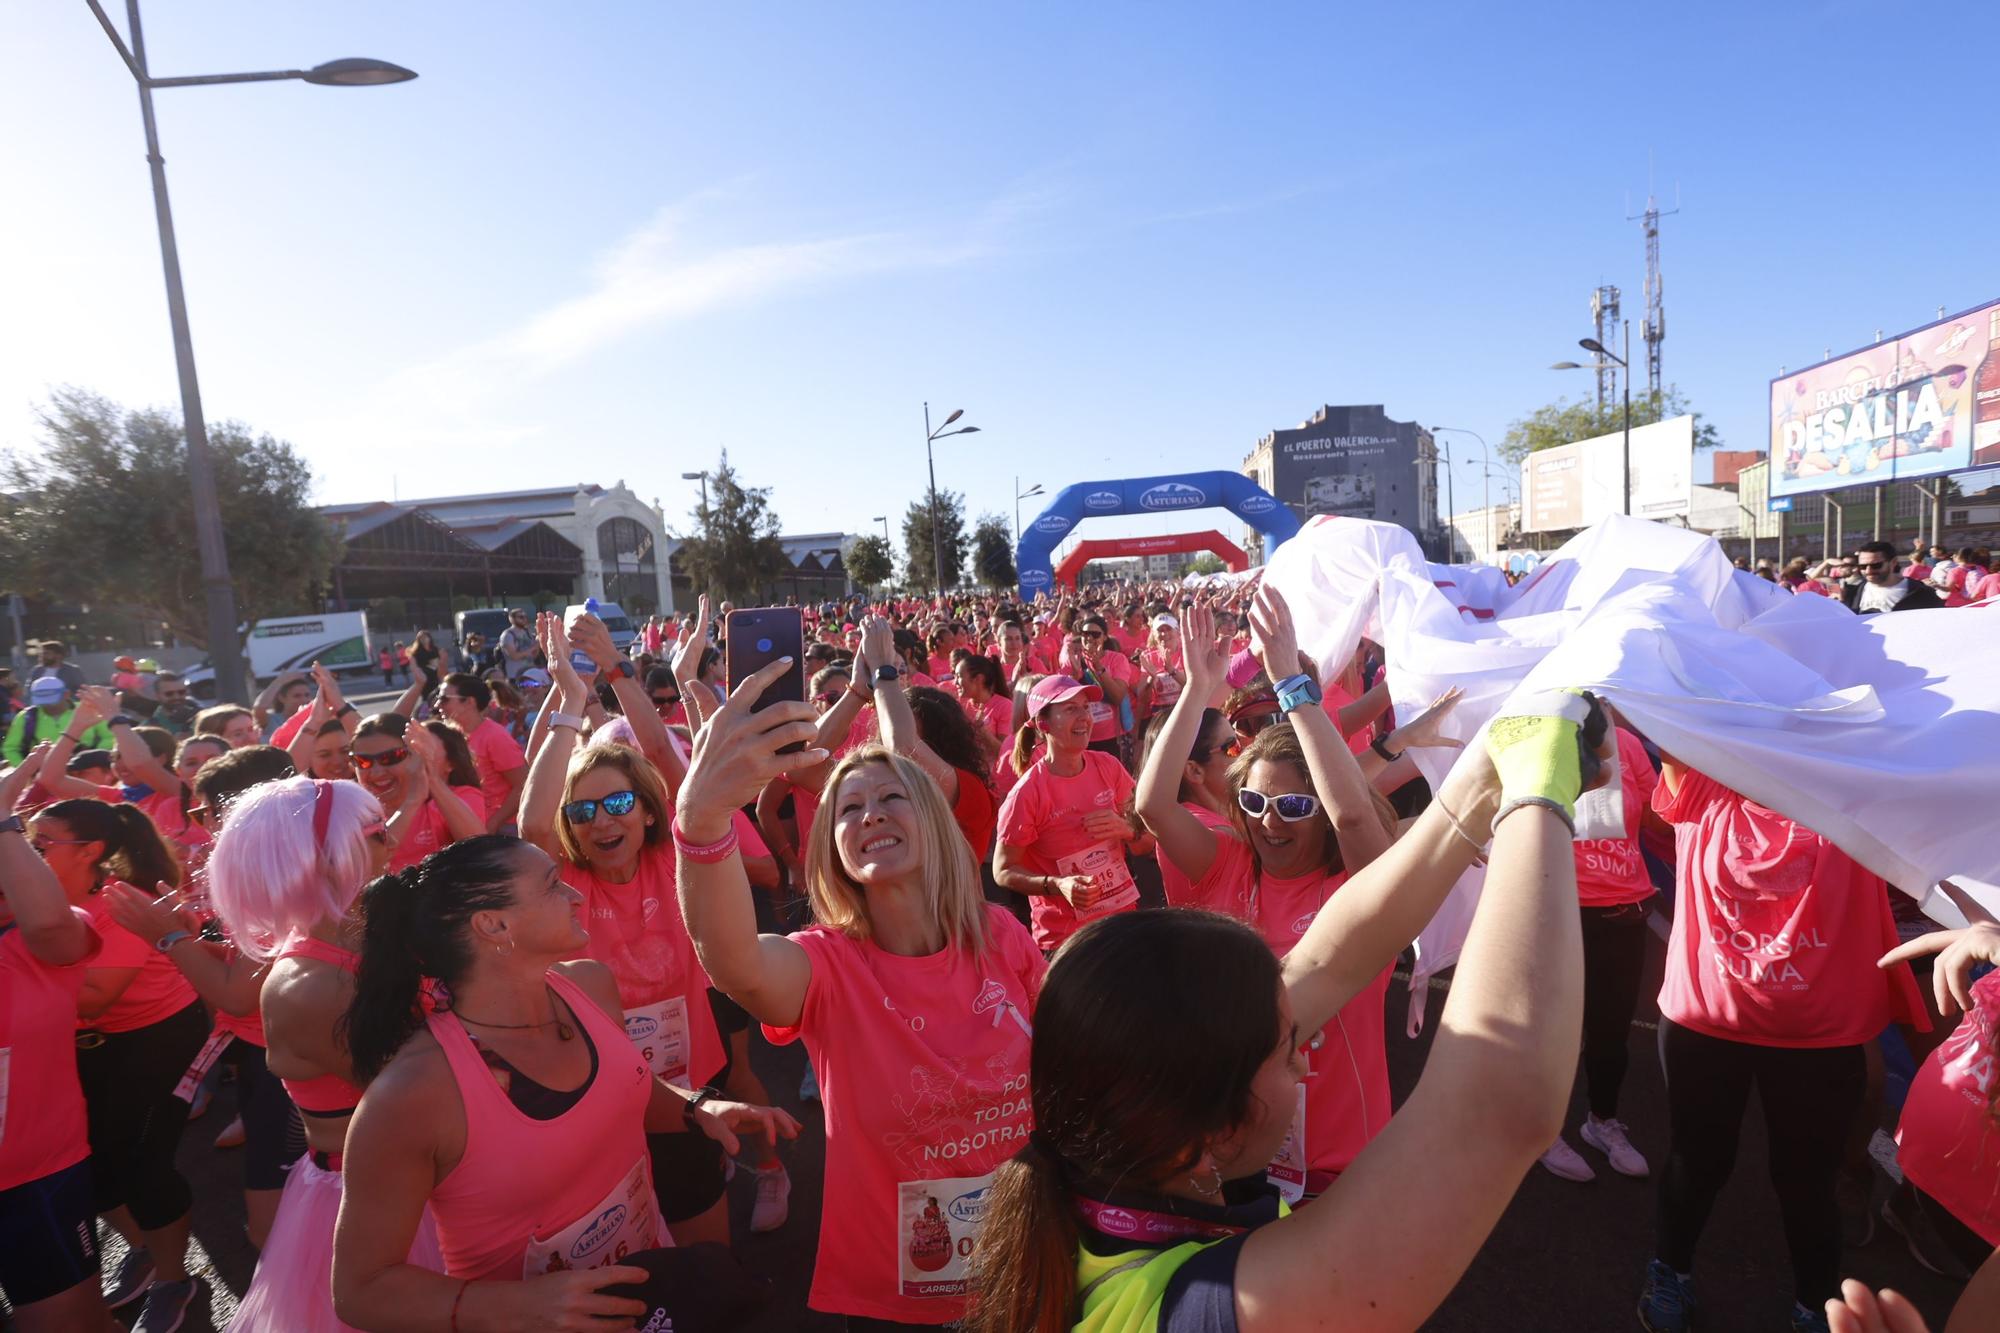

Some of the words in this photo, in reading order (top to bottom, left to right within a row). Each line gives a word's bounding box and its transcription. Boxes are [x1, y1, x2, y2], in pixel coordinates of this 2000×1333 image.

[1782, 383, 1943, 457] DESALIA
[1284, 444, 1294, 452] EL
[1296, 438, 1331, 451] PUERTO
[1293, 451, 1345, 461] Restaurante
[1145, 494, 1201, 506] ASTURIANA
[1003, 1073, 1028, 1096] PO
[974, 1098, 1032, 1125] TODA
[924, 1119, 1032, 1161] NOSOTRA
[576, 1211, 624, 1255] ASTURIANA
[919, 1284, 965, 1294] CARRERA
